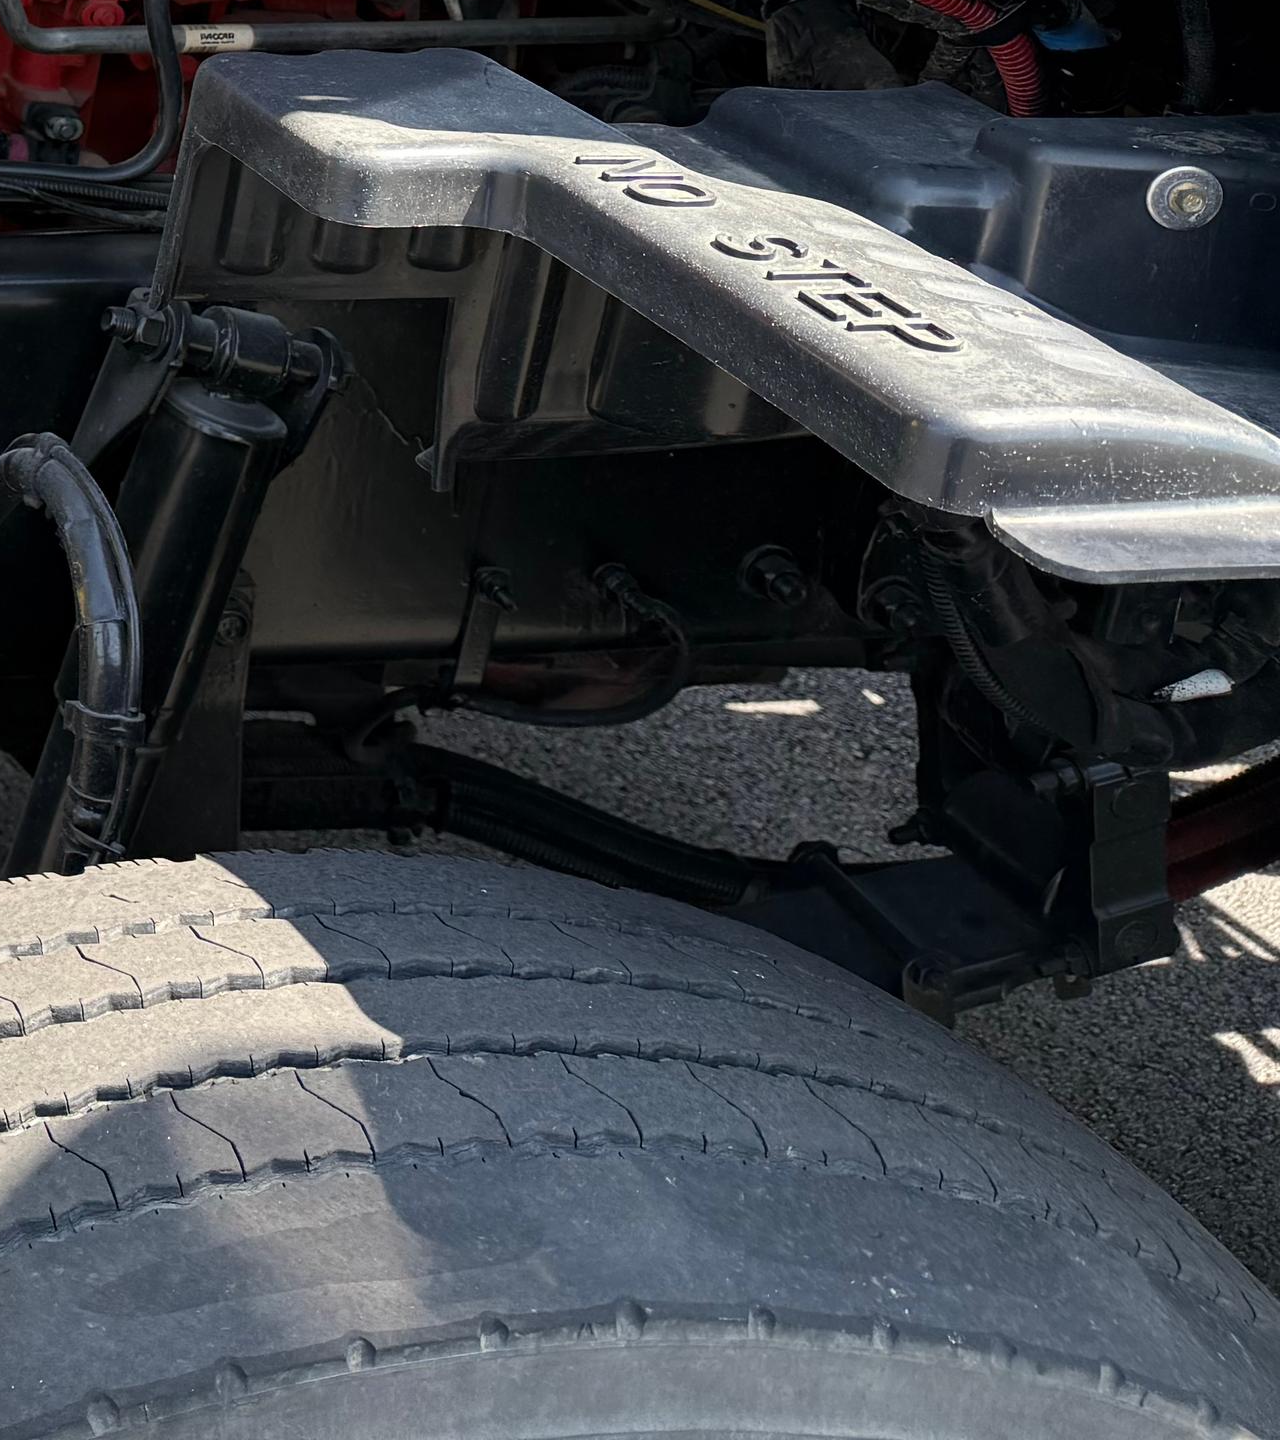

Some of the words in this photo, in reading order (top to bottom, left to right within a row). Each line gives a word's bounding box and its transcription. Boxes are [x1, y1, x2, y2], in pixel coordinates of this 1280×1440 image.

[200, 33, 235, 41] PACCAR
[575, 155, 716, 207] NO
[710, 233, 967, 352] STEP
